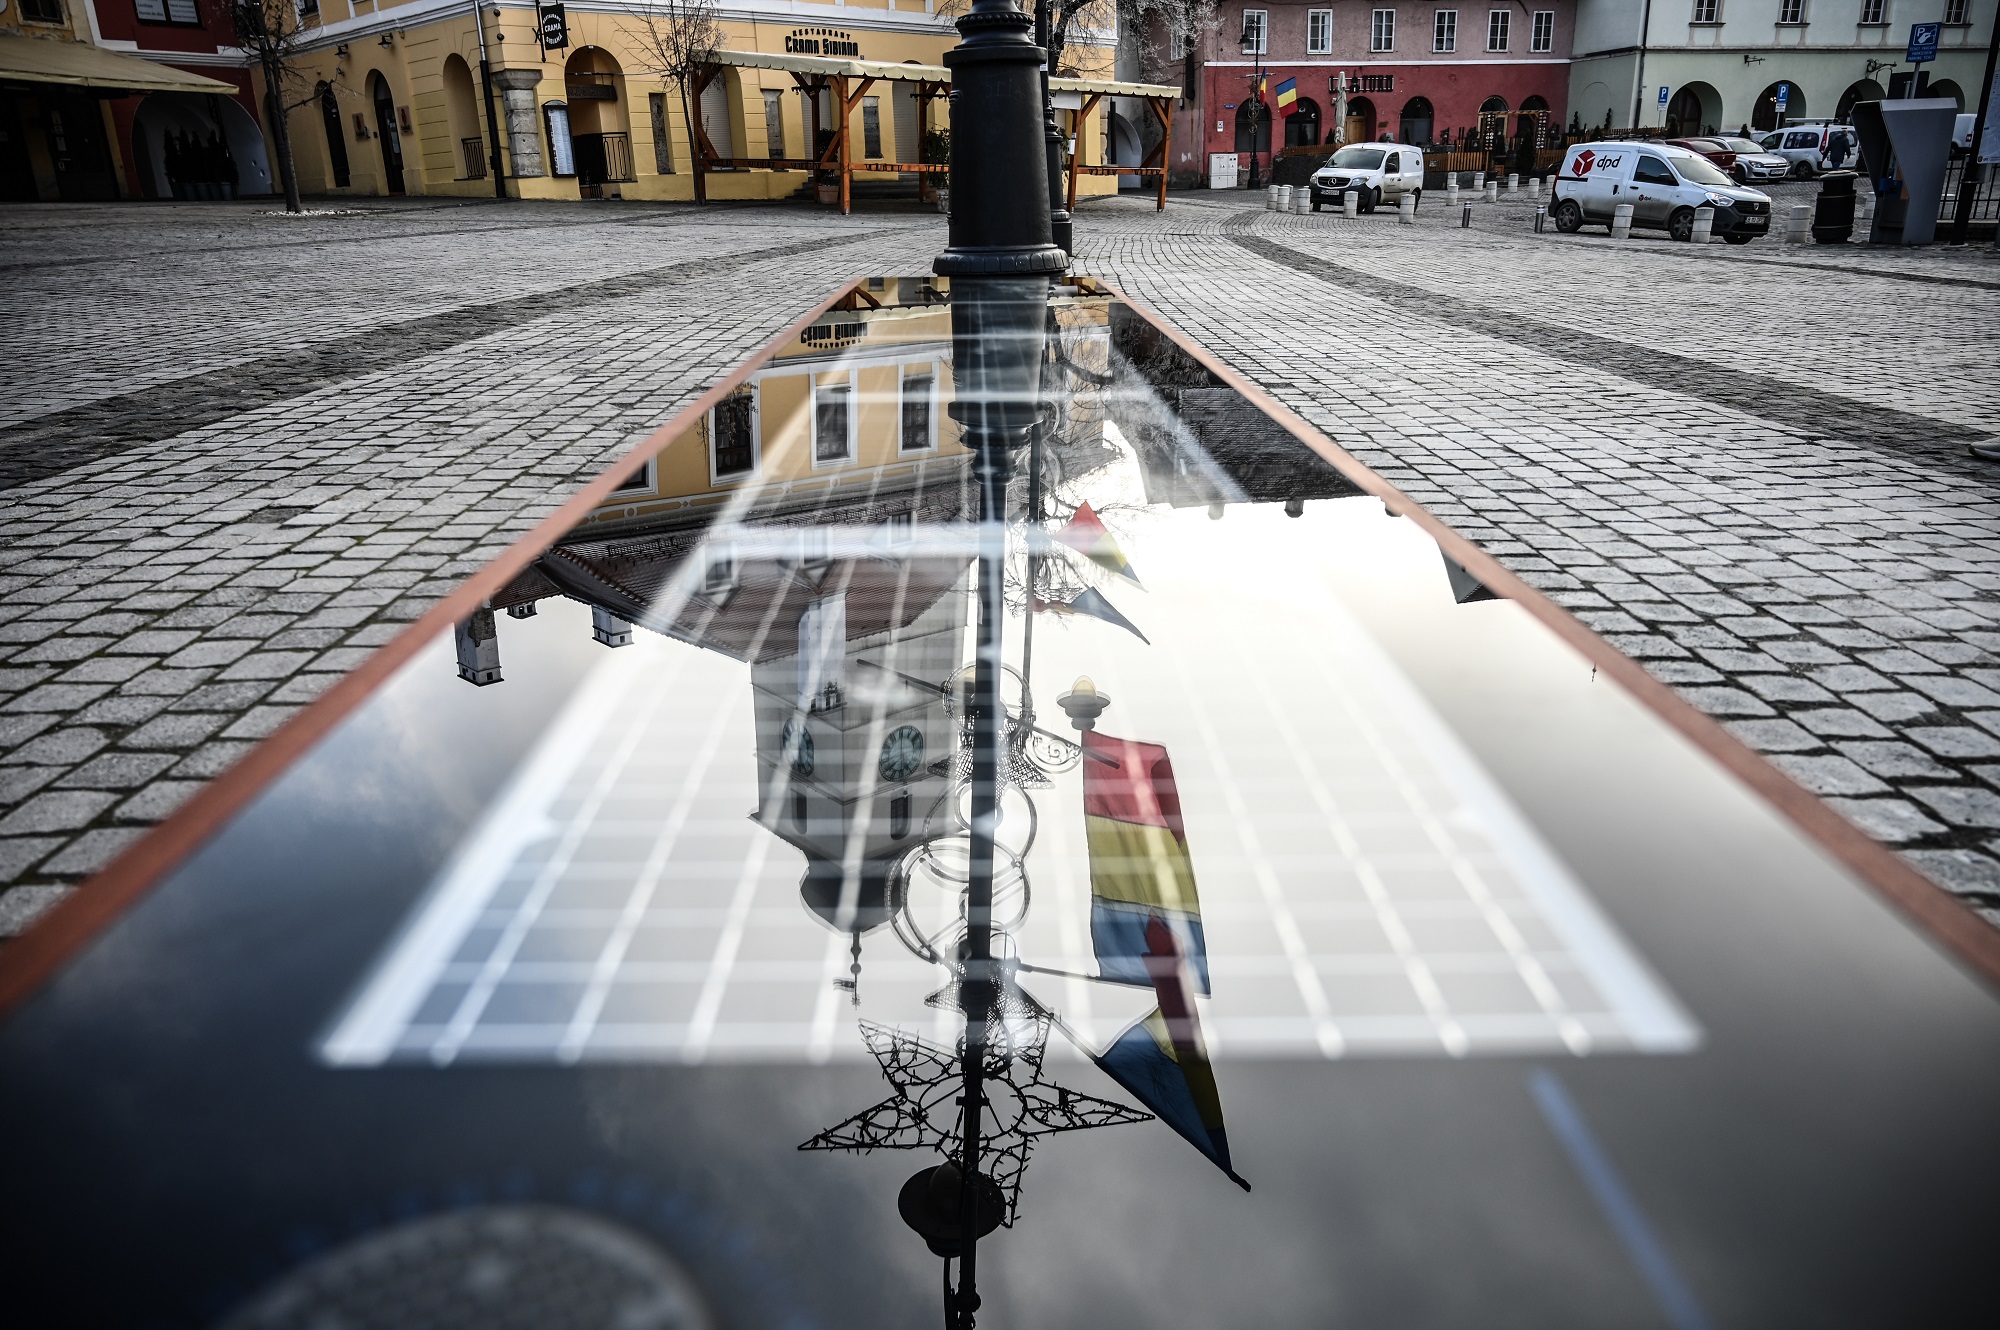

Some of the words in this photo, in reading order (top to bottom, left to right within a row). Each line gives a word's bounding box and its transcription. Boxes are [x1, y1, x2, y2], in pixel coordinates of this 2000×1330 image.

[544, 23, 562, 33] CRAMA
[792, 28, 851, 41] RESTAURANT
[785, 35, 820, 54] CRAMA
[822, 38, 859, 57] SIBIANA
[1596, 155, 1623, 171] dpd
